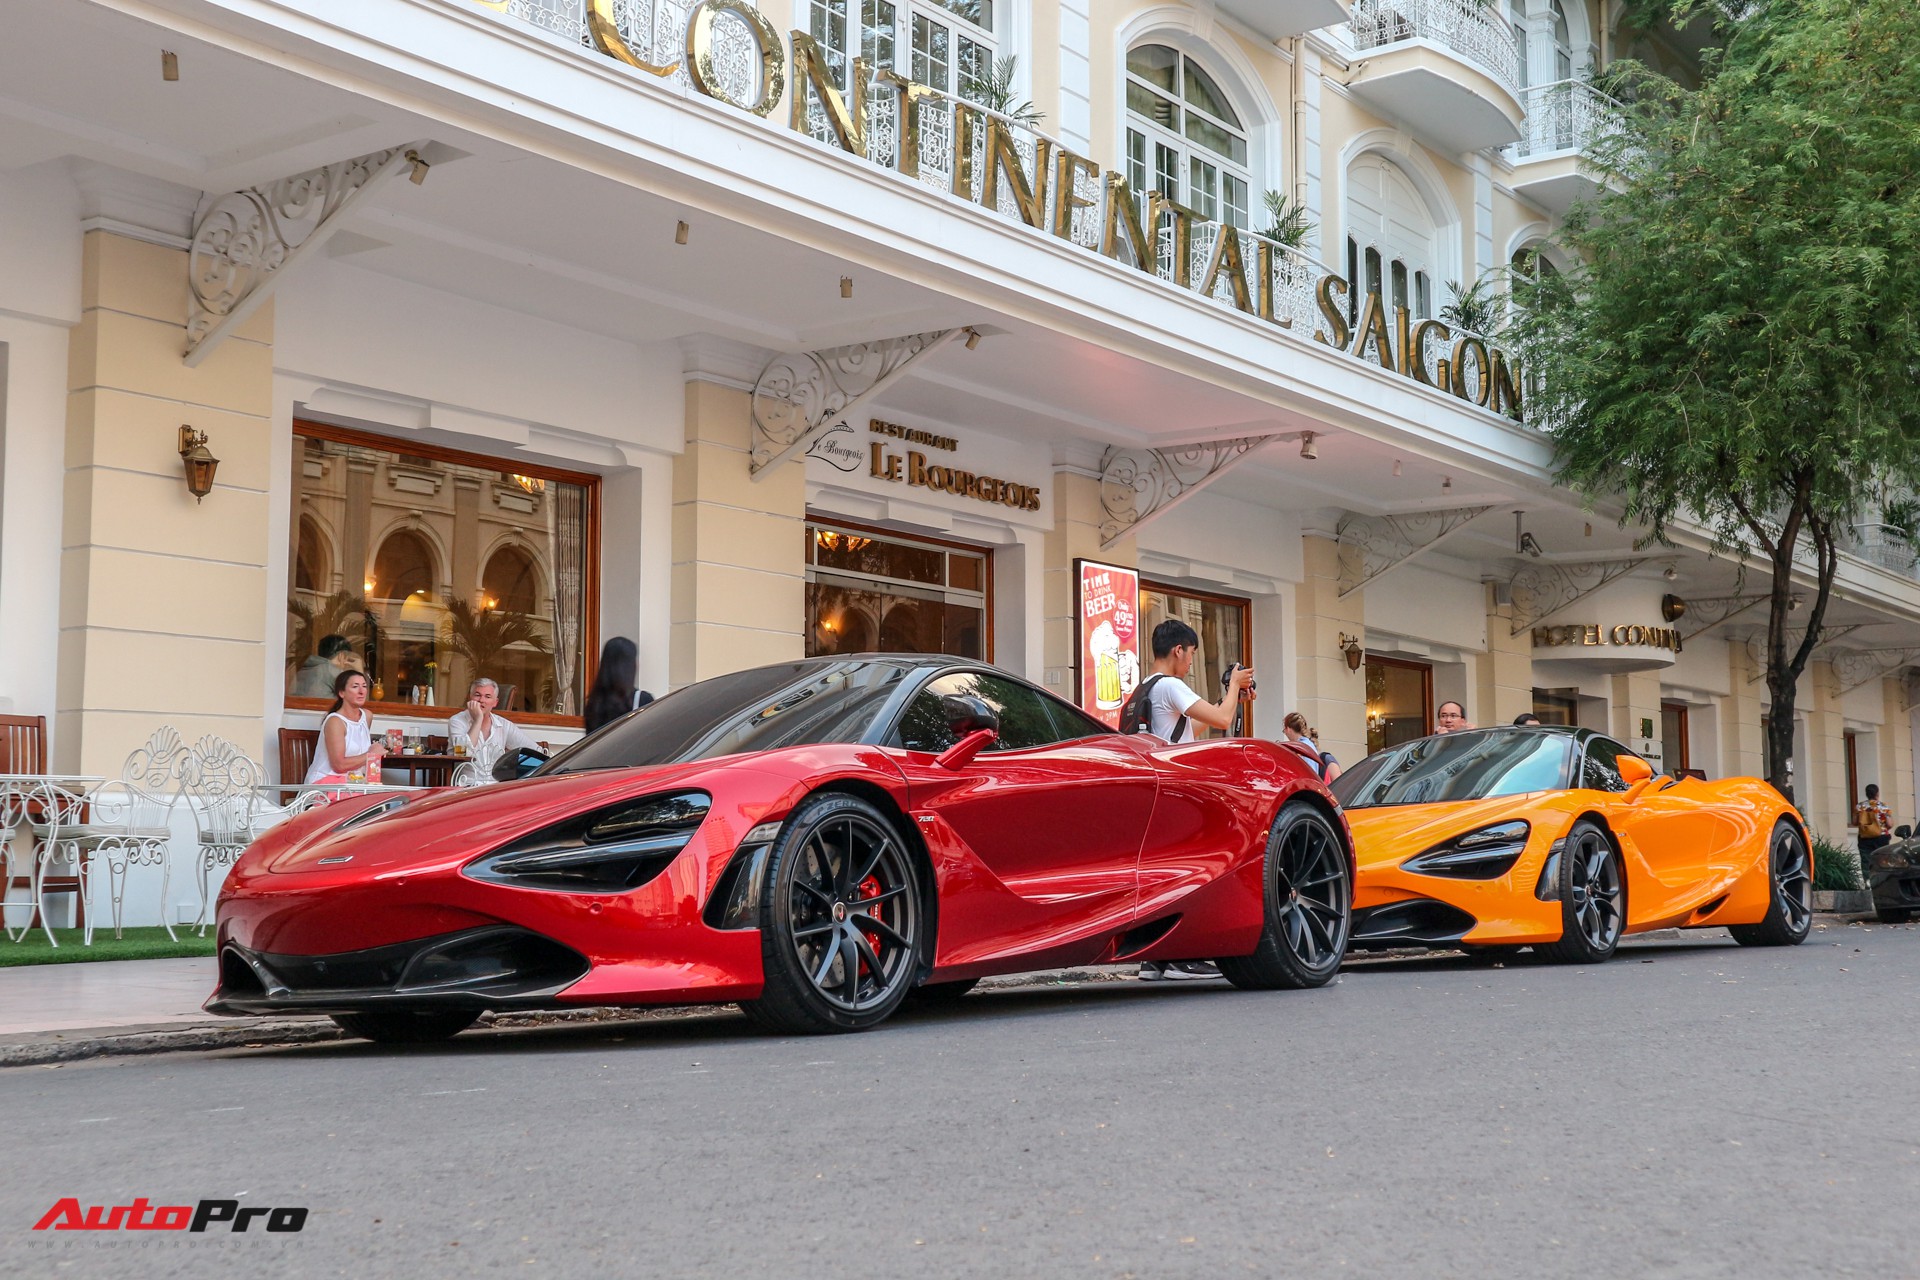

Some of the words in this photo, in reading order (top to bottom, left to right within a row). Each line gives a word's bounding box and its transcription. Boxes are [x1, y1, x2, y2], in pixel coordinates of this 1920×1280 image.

[583, 0, 1292, 329] CONTINENTAL
[1313, 274, 1524, 423] SAIGON
[870, 418, 959, 452] RESTAURANT
[824, 439, 864, 462] Bourgeois
[907, 450, 1041, 512] BOURGEOIS
[1083, 572, 1110, 591] TIME
[1084, 590, 1093, 600] TO
[1094, 585, 1112, 598] DRINK
[1085, 593, 1117, 618] BEER
[1114, 611, 1127, 626] 49
[1531, 624, 1608, 648] HOTEL
